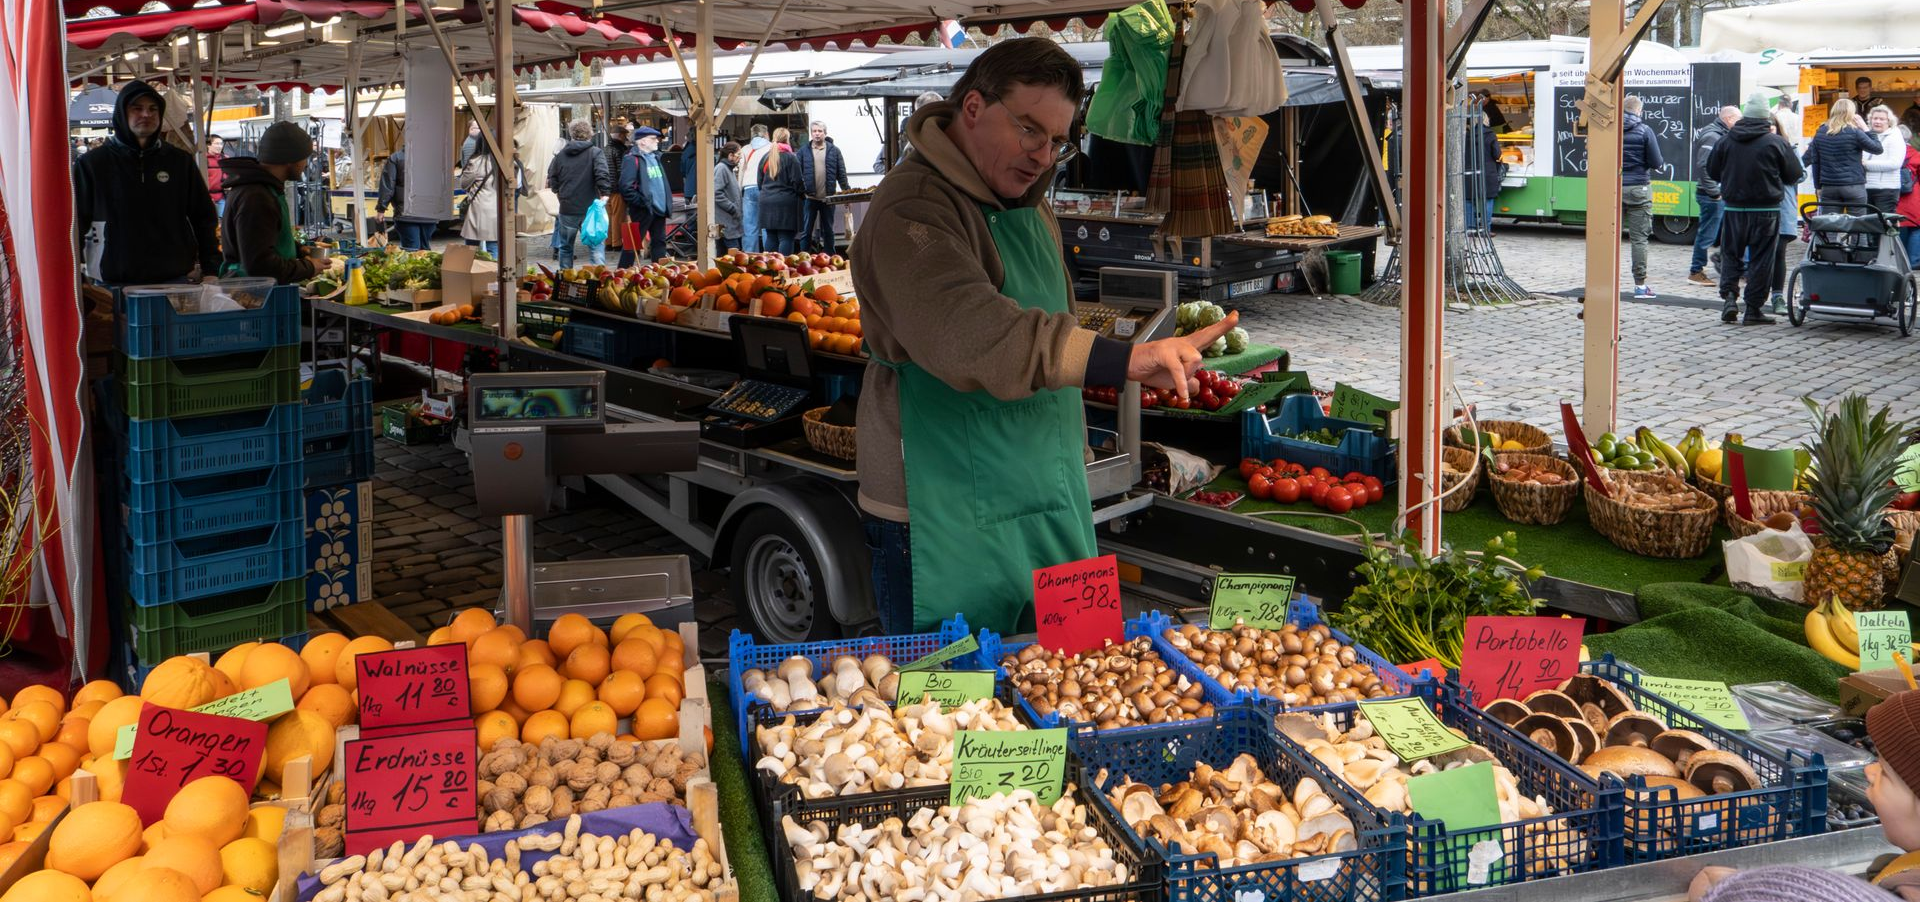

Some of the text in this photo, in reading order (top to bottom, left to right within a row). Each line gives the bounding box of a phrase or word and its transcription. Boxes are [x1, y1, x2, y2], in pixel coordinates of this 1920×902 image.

[1633, 68, 1690, 76] Wochenmarkt
[1645, 78, 1682, 86] zusammen
[1652, 192, 1680, 205] SKE
[1038, 566, 1115, 590] Champignons
[1218, 578, 1291, 595] Champignons
[1860, 612, 1905, 628] Datteln
[1475, 625, 1568, 651] Portobello
[362, 656, 461, 679] Walnüsse
[1538, 658, 1561, 679] 90
[925, 673, 952, 689] Bio
[395, 681, 425, 711] 11
[433, 676, 456, 694] 80
[147, 709, 251, 757] Orangen
[957, 733, 1065, 762] Kräuterseitlinge
[211, 757, 246, 777] 30
[355, 744, 466, 774] Erdnüsse
[959, 765, 983, 780] Bio
[1021, 762, 1051, 782] 20
[392, 772, 433, 813] 15
[443, 770, 468, 788] 80
